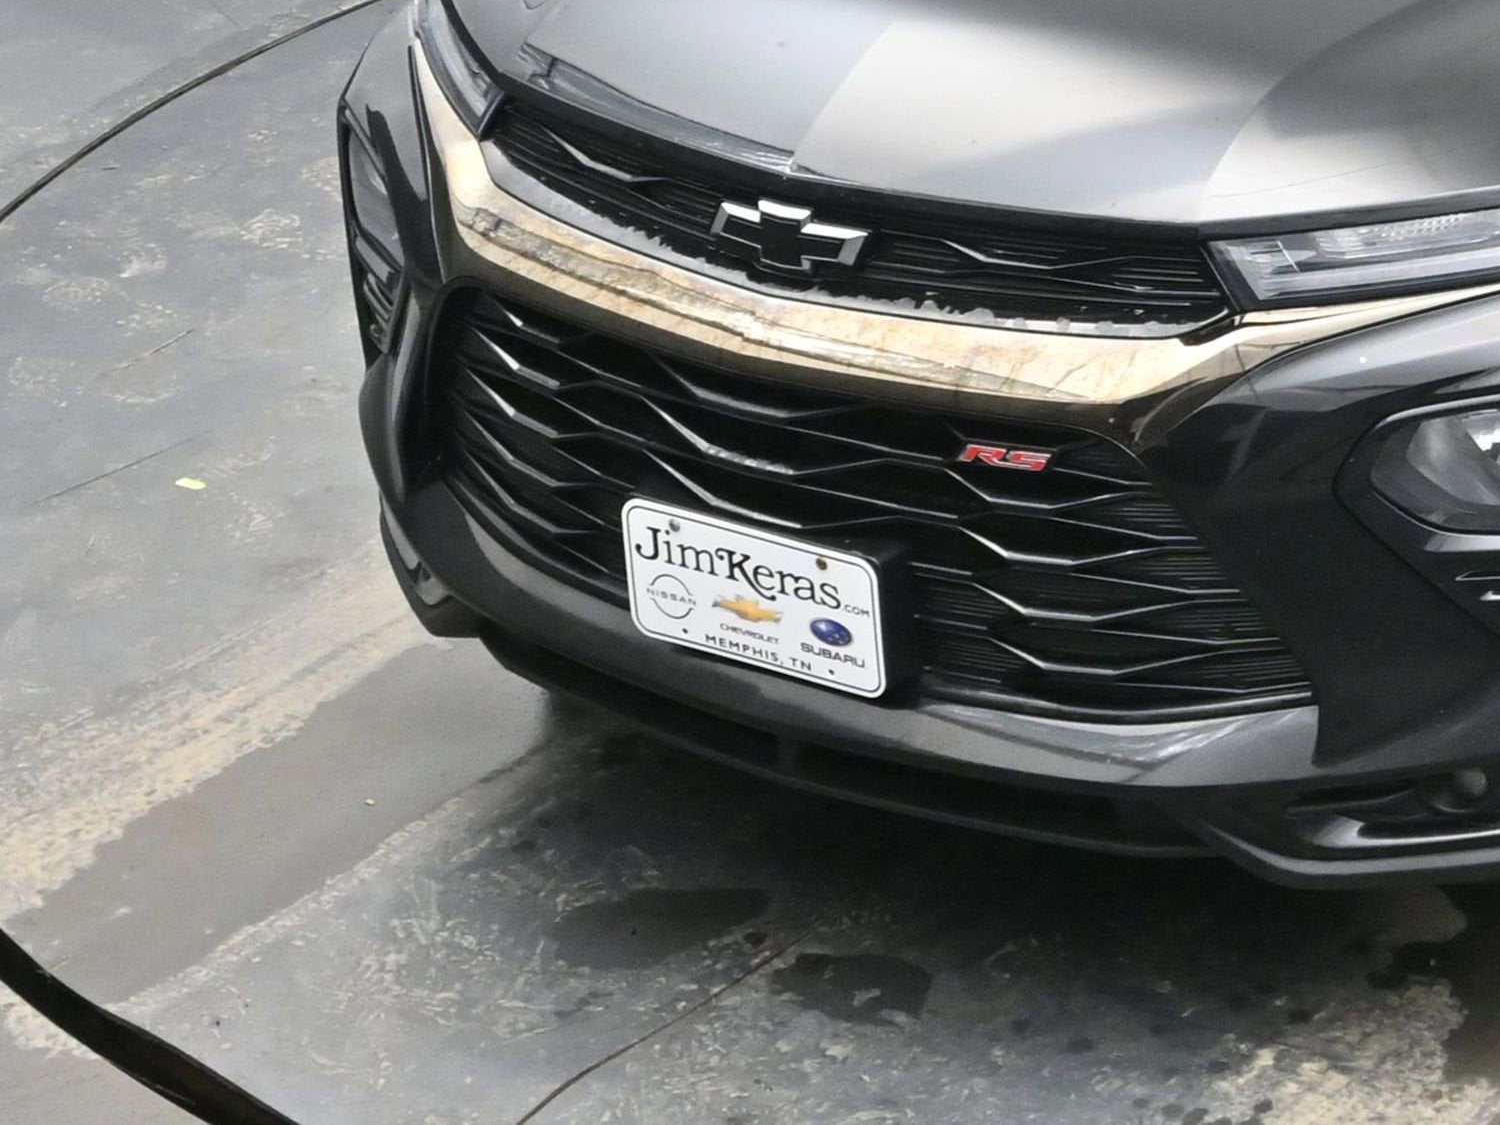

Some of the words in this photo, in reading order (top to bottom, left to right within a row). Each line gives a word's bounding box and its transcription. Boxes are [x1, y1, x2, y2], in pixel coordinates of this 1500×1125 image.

[956, 444, 1052, 472] RS
[646, 587, 698, 607] NISSAN
[719, 623, 780, 645] CHEVROLET
[789, 657, 812, 672] TN
[800, 641, 866, 669] SUBARU
